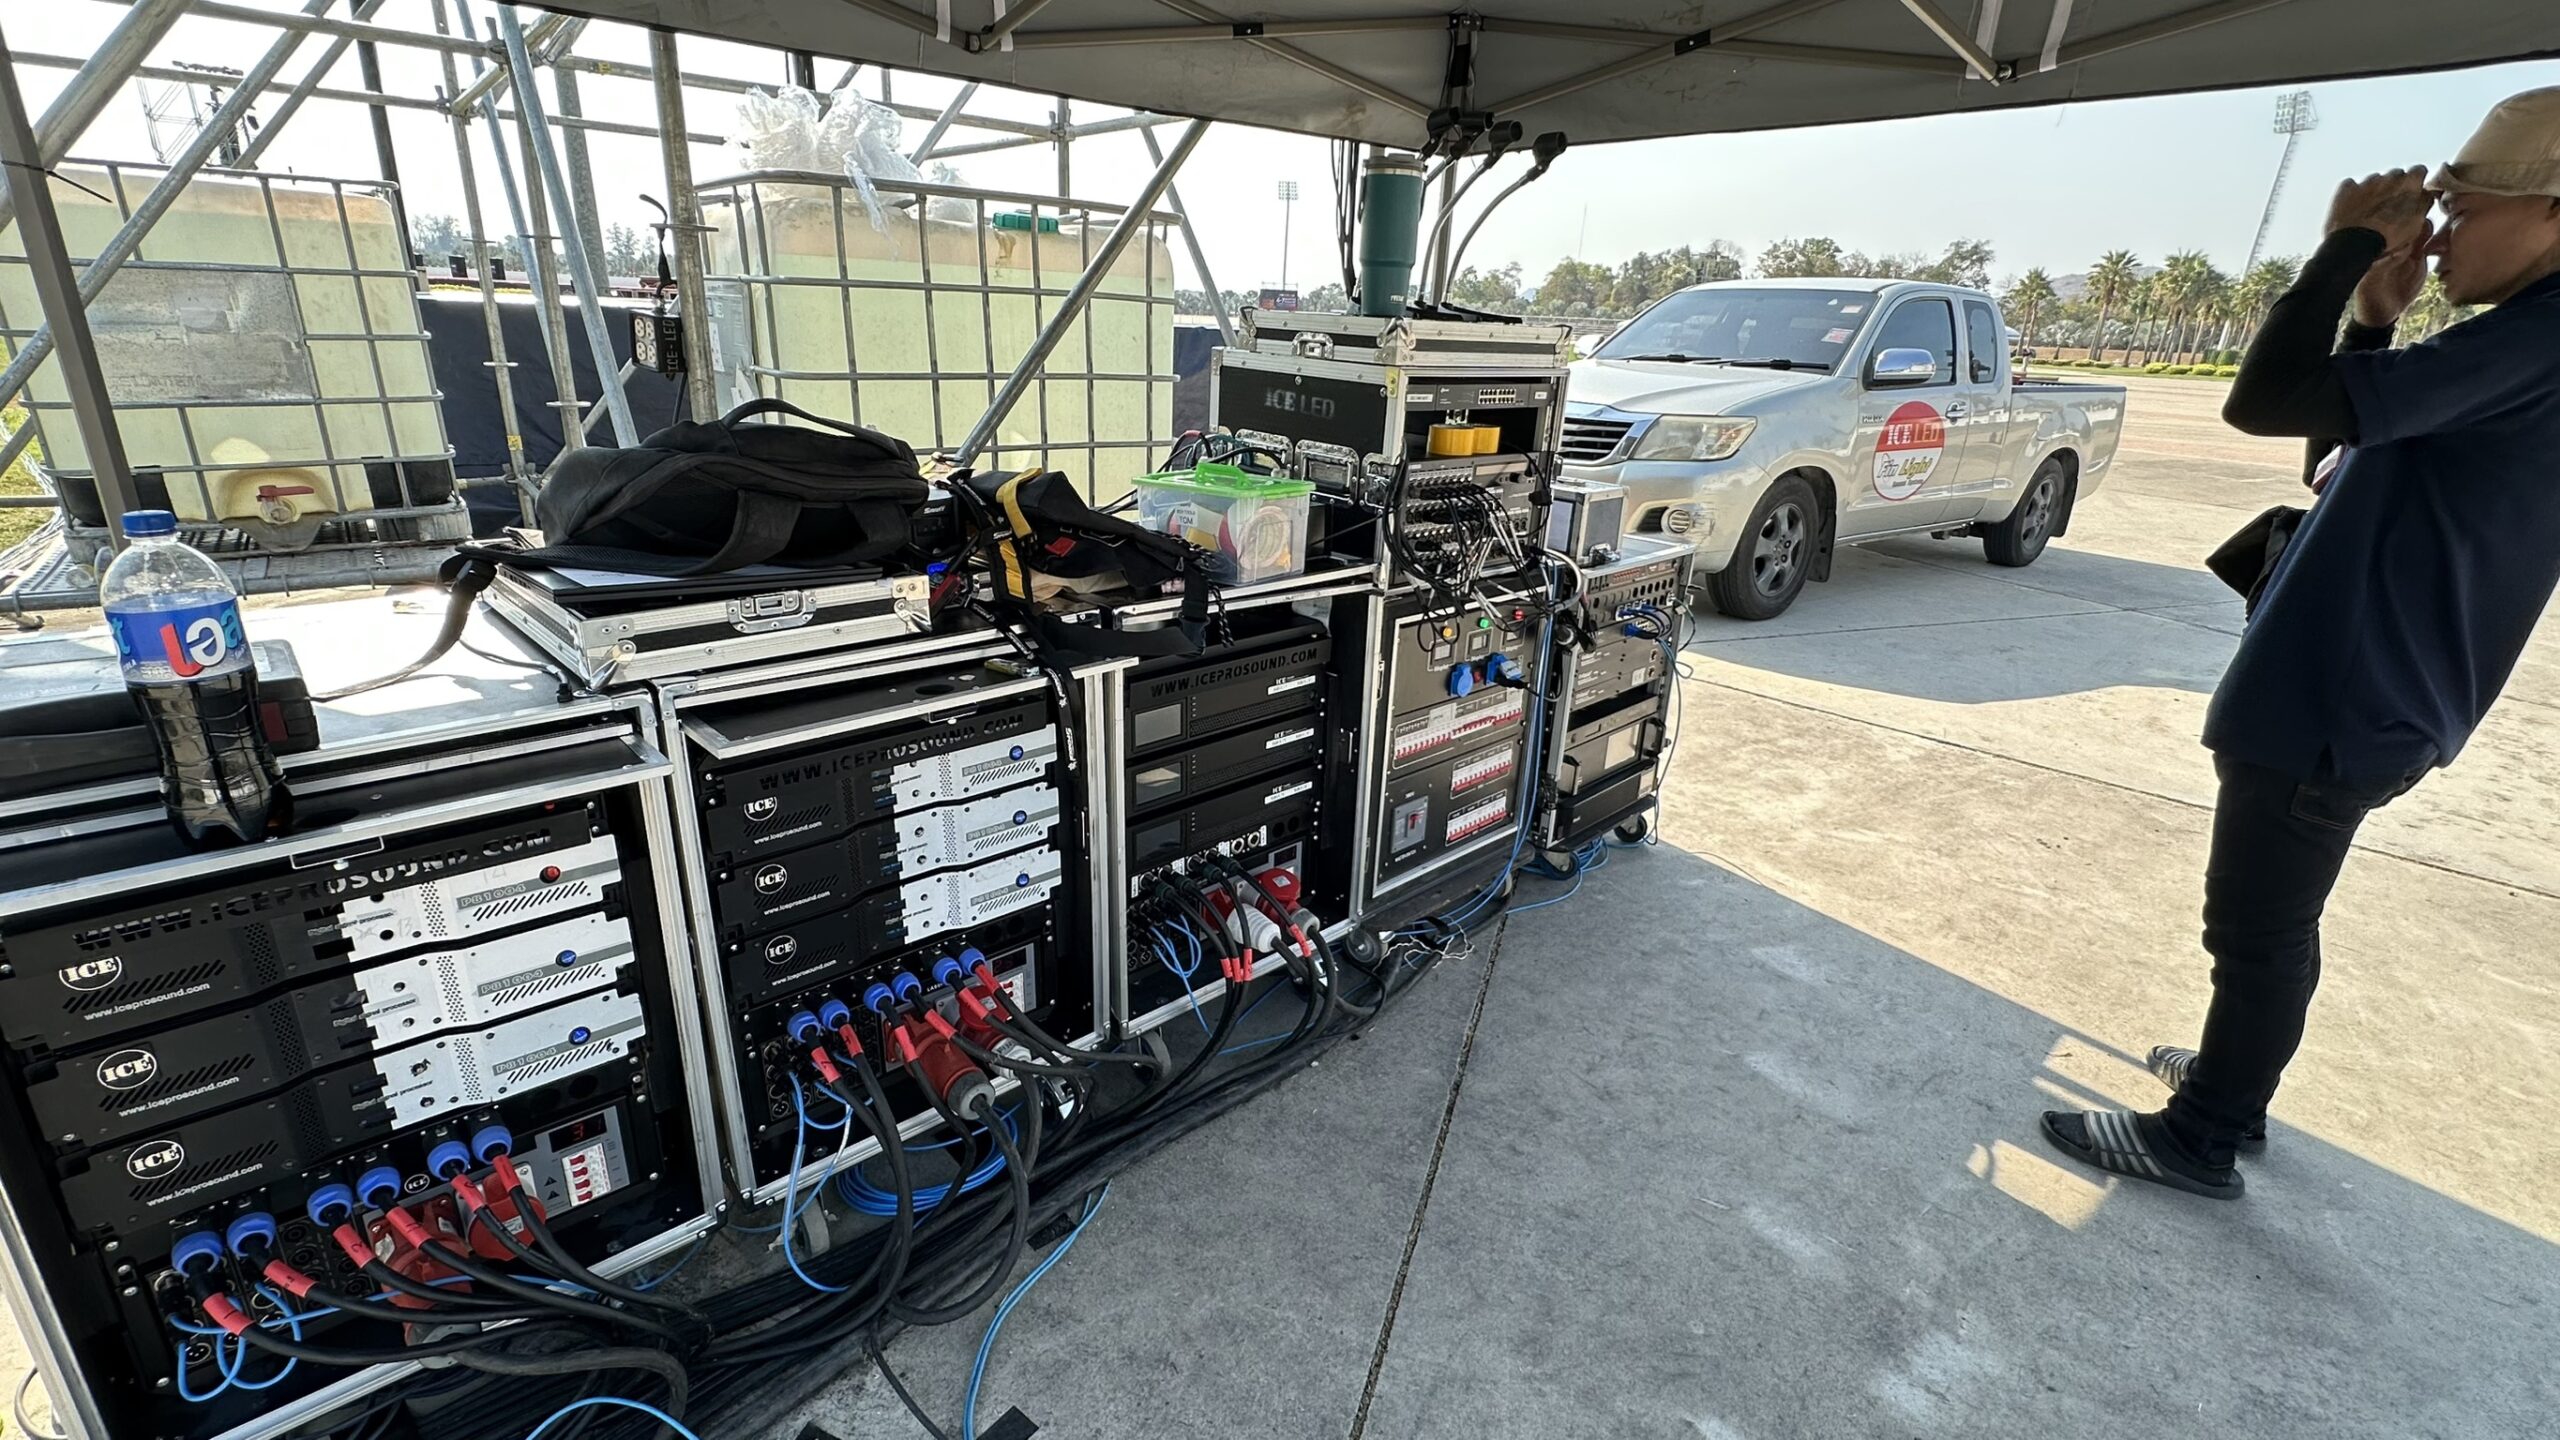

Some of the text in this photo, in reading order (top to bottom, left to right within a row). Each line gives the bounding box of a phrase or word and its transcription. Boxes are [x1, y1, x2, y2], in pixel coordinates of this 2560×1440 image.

[1264, 387, 1336, 420] ICE LED
[1886, 422, 1940, 446] ICE LED
[1898, 456, 1933, 479] Light
[1150, 647, 1318, 698] WWW.ICEPROSOUND.COM
[746, 797, 775, 815] ICE
[71, 828, 552, 953] WWW.ICEPROSOUND.COM
[757, 872, 786, 888] ICE
[767, 942, 795, 959] ICE
[61, 957, 118, 983] ICE
[83, 981, 211, 1022] www.iceprosound.com
[102, 1054, 153, 1083] ICE
[118, 1074, 240, 1118] www.iceprosound.com
[131, 1145, 182, 1173] ICE
[146, 1161, 264, 1208] www.iceprosound.com
